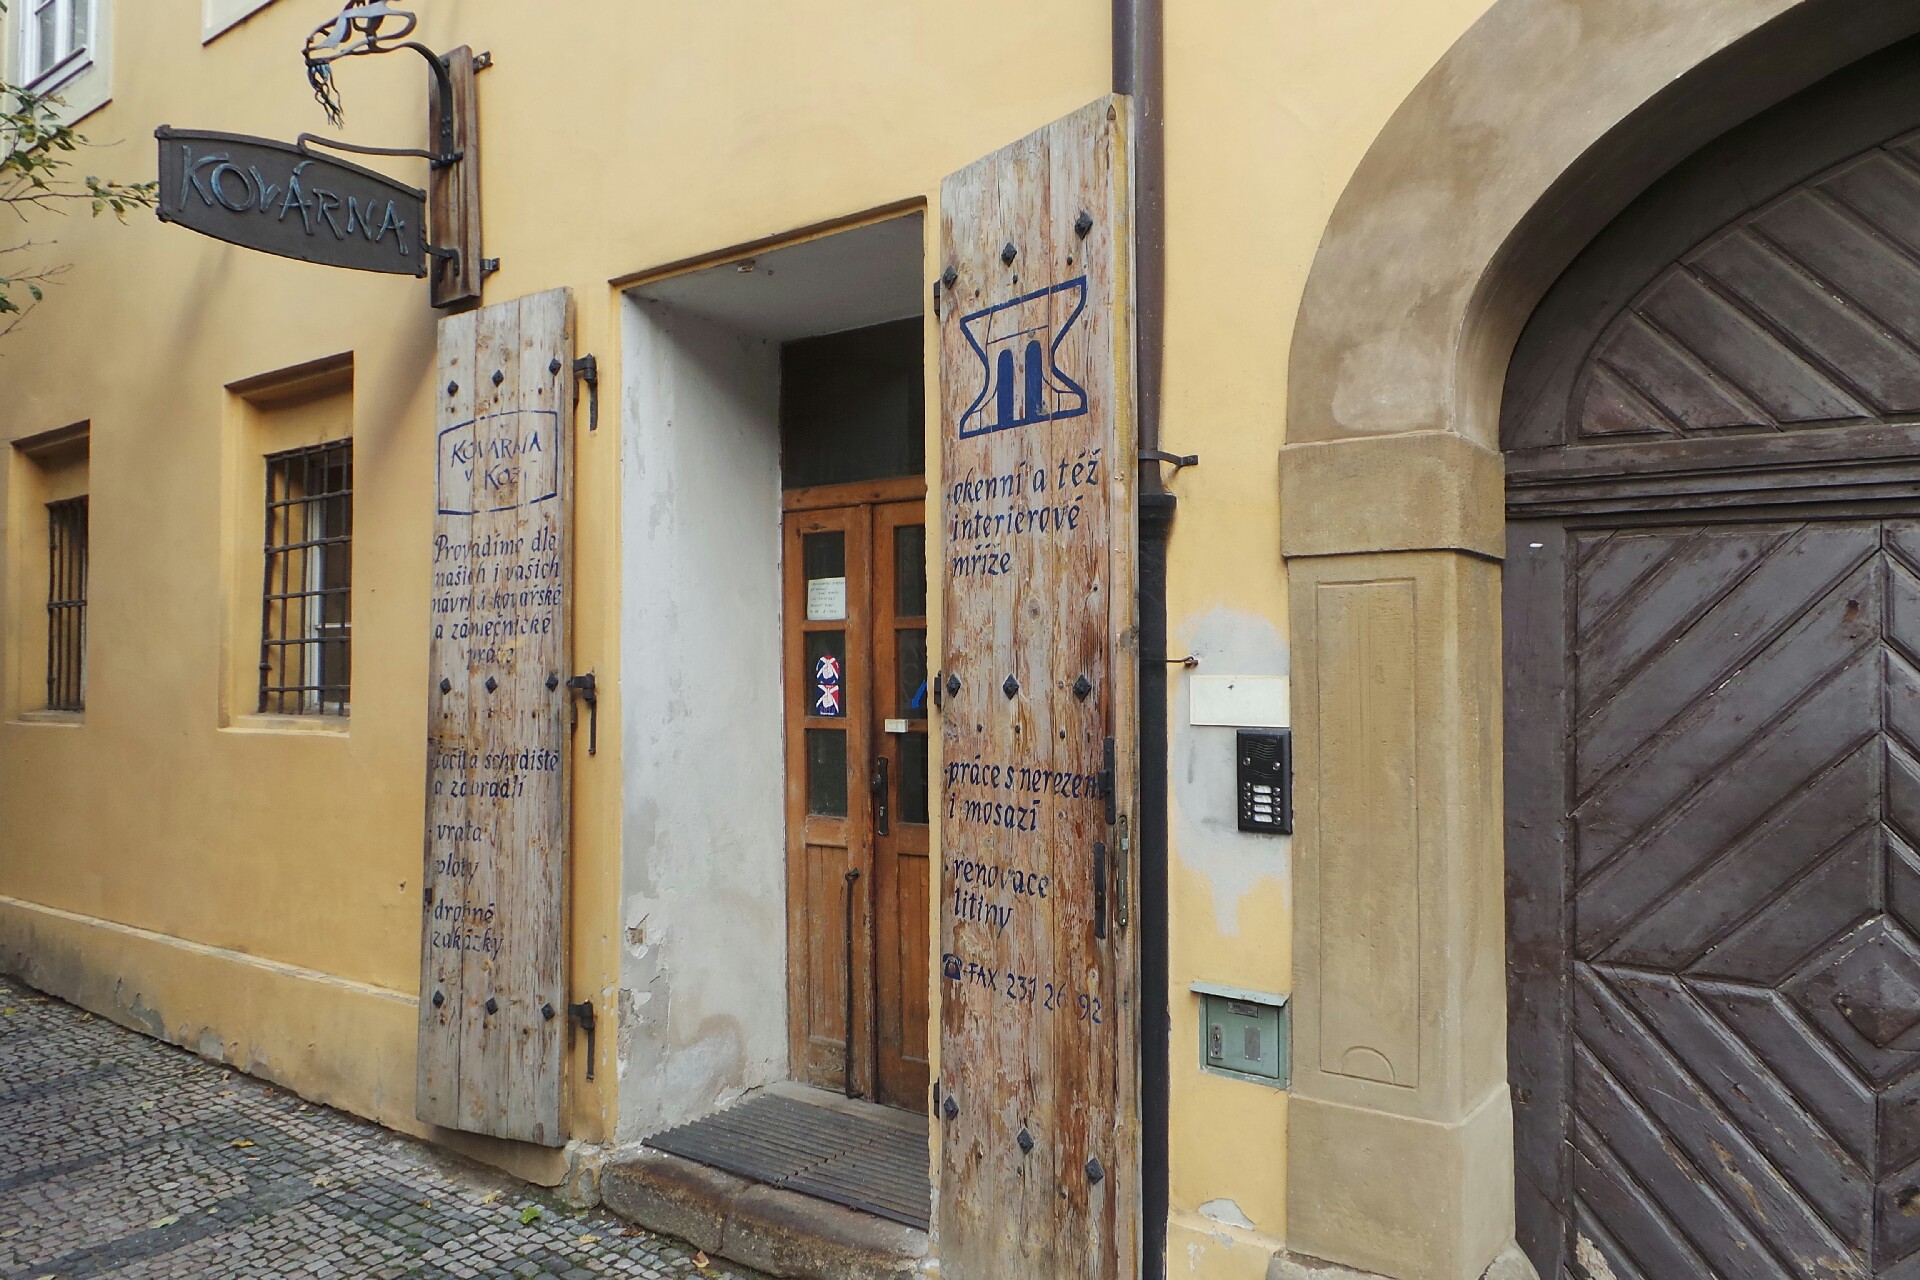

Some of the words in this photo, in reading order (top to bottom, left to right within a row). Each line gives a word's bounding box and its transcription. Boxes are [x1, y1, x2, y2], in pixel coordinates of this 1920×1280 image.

[179, 145, 409, 256] KOVÁRNA
[953, 459, 1027, 506] okenní
[1032, 467, 1047, 494] a
[1058, 447, 1102, 491] též
[531, 525, 557, 552] dle
[435, 560, 486, 587] našich
[493, 562, 500, 583] i
[505, 553, 560, 581] vašich
[434, 623, 444, 640] a
[434, 780, 443, 796] a
[947, 754, 1001, 789] práce
[1005, 765, 1015, 790] s
[949, 792, 956, 819] i
[964, 799, 1041, 832] mosazí
[437, 819, 483, 842] vrata
[954, 859, 1050, 899] renovace
[954, 887, 1014, 940] litiny
